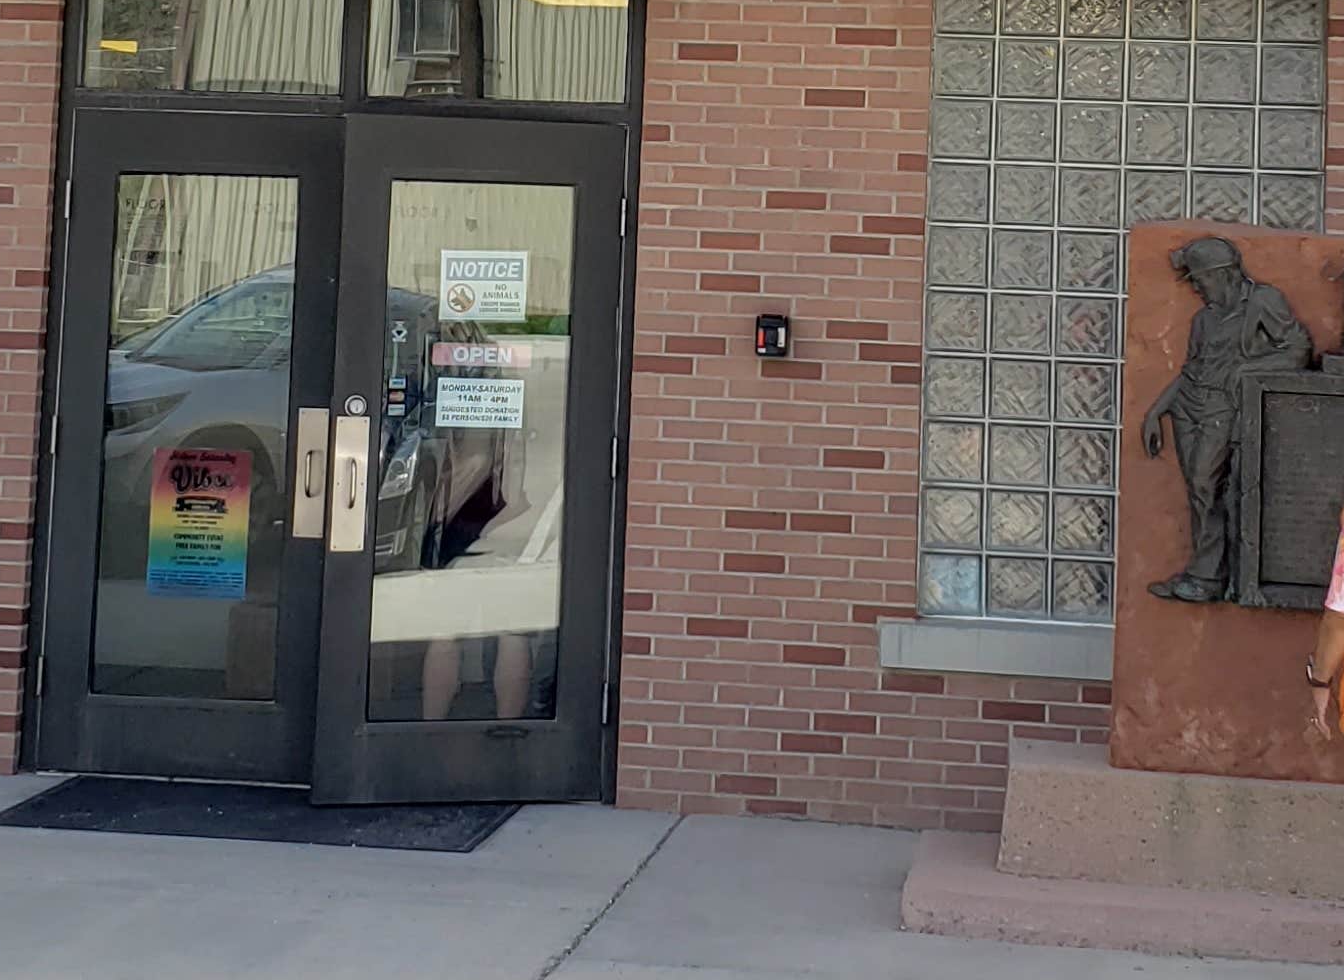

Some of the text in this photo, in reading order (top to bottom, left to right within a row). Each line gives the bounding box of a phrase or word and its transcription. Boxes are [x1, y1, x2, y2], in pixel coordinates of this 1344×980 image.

[449, 260, 521, 278] NOTICE
[495, 283, 507, 291] NO
[481, 291, 519, 300] ANIMALS
[452, 346, 513, 364] OPEN
[457, 394, 482, 403] 11AM
